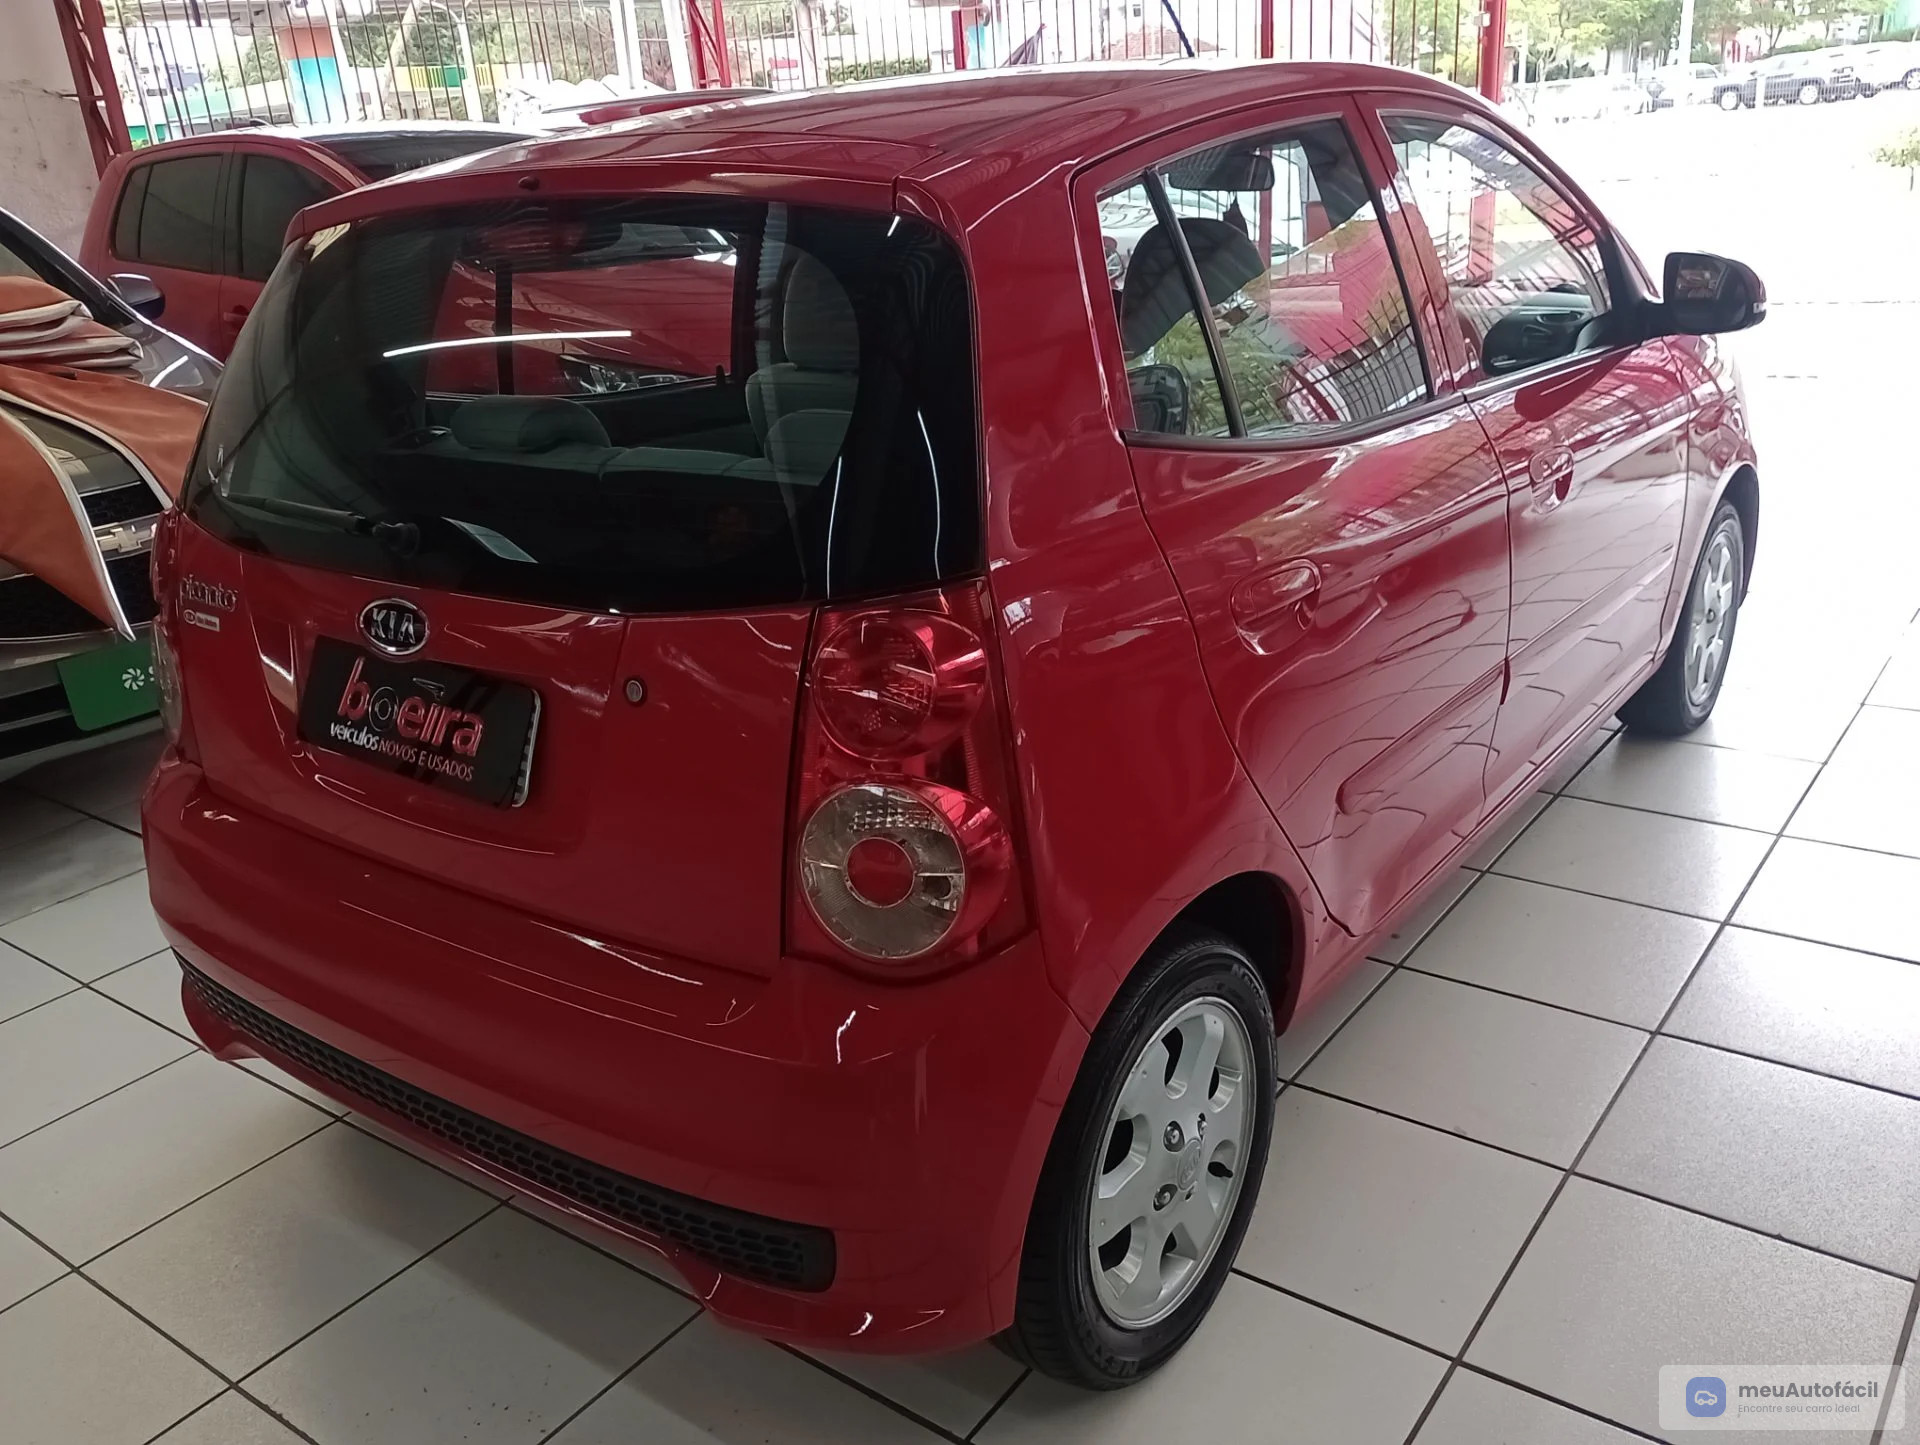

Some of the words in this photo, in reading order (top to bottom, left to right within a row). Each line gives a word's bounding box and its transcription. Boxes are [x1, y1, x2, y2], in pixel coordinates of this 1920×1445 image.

[369, 607, 416, 645] KIA
[337, 656, 485, 757] boeira
[330, 721, 379, 752] veículos
[378, 736, 418, 764] NOVOS
[418, 749, 426, 766] E
[427, 754, 476, 783] USADOS
